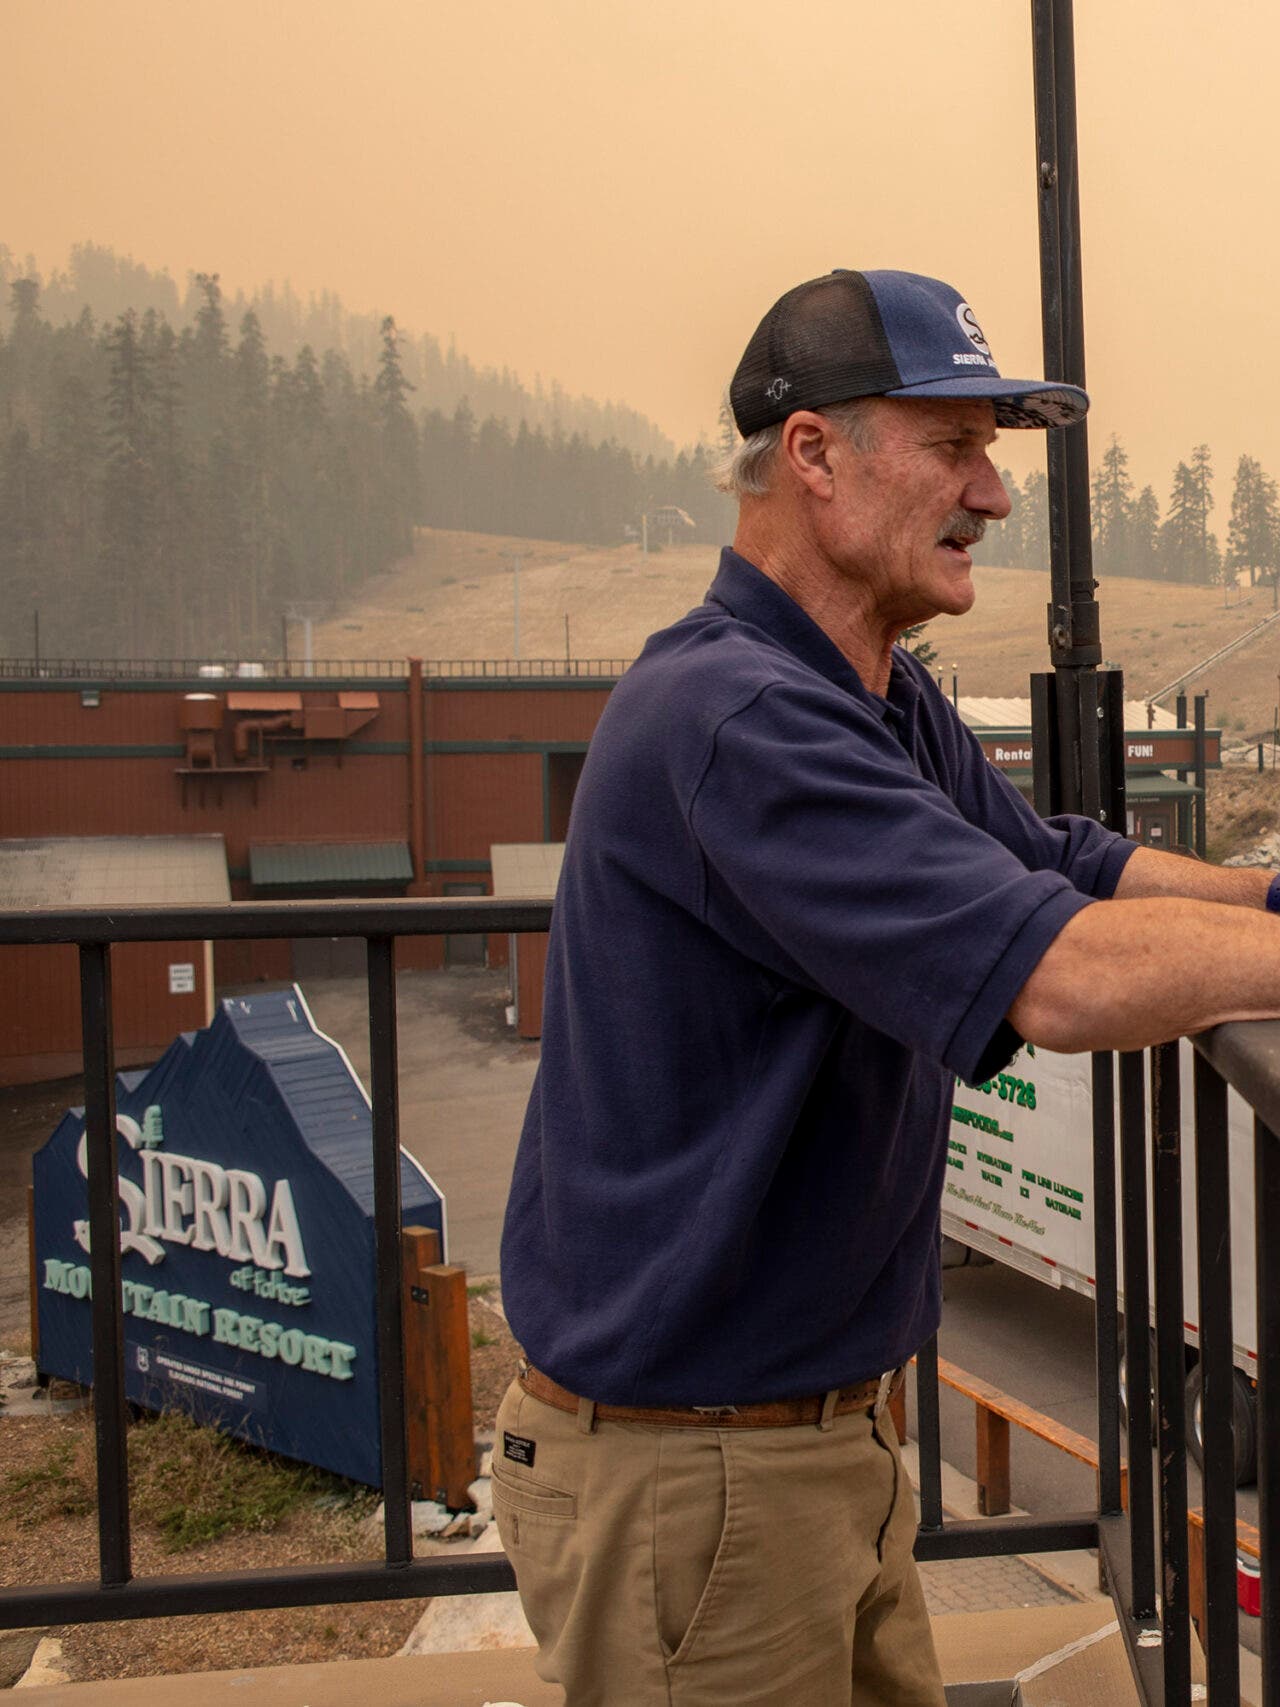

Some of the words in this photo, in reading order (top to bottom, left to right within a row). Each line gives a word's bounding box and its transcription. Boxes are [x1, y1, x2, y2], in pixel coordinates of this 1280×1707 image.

[953, 353, 987, 366] SIERRA
[1127, 745, 1153, 758] FUN!
[43, 1259, 210, 1336] MOTAIN
[212, 1308, 357, 1380] RESORT
